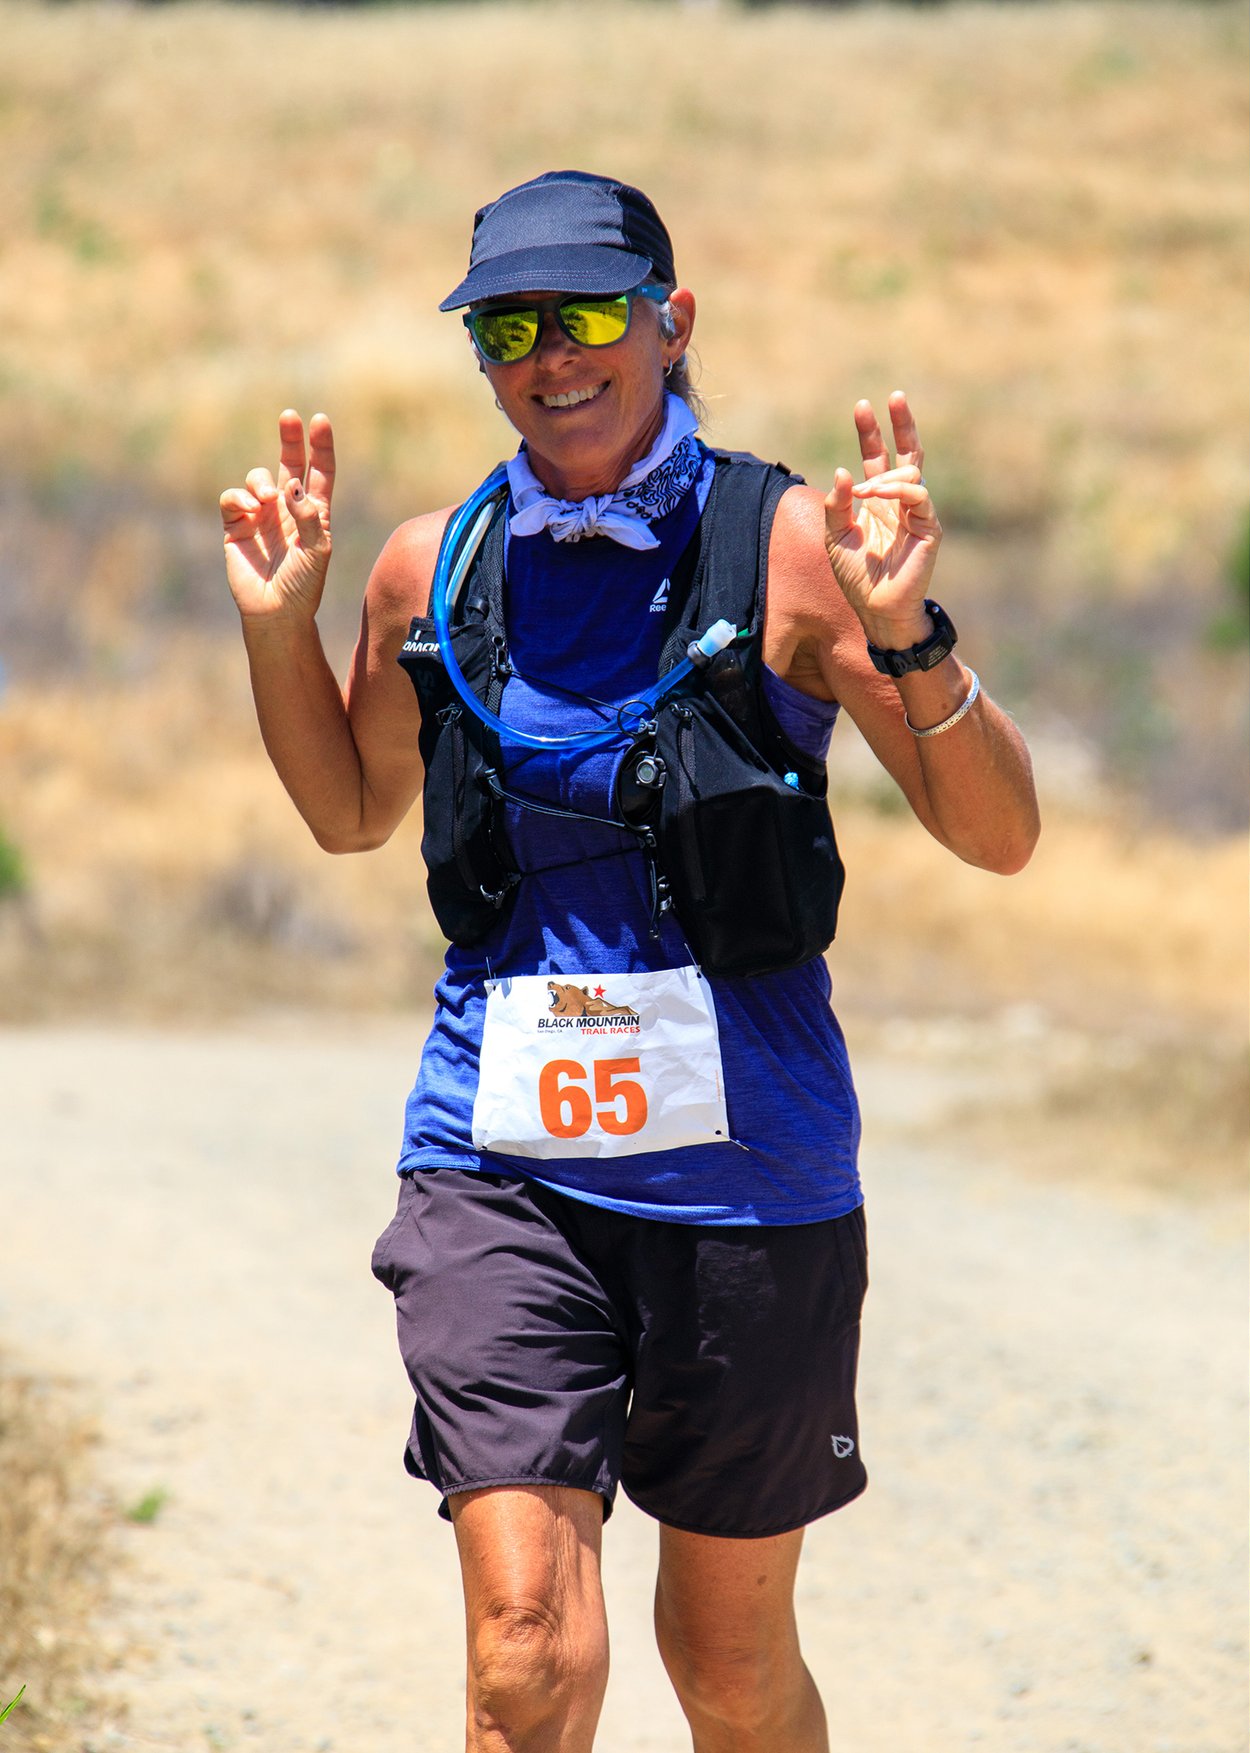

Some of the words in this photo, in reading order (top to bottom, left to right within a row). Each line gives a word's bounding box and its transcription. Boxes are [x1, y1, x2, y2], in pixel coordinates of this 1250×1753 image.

[537, 1017, 574, 1028] BLACK
[576, 1015, 640, 1028] MOUNTAIN
[580, 1027, 608, 1035] TRAIL
[609, 1026, 640, 1034] RACES
[538, 1057, 649, 1139] 65
